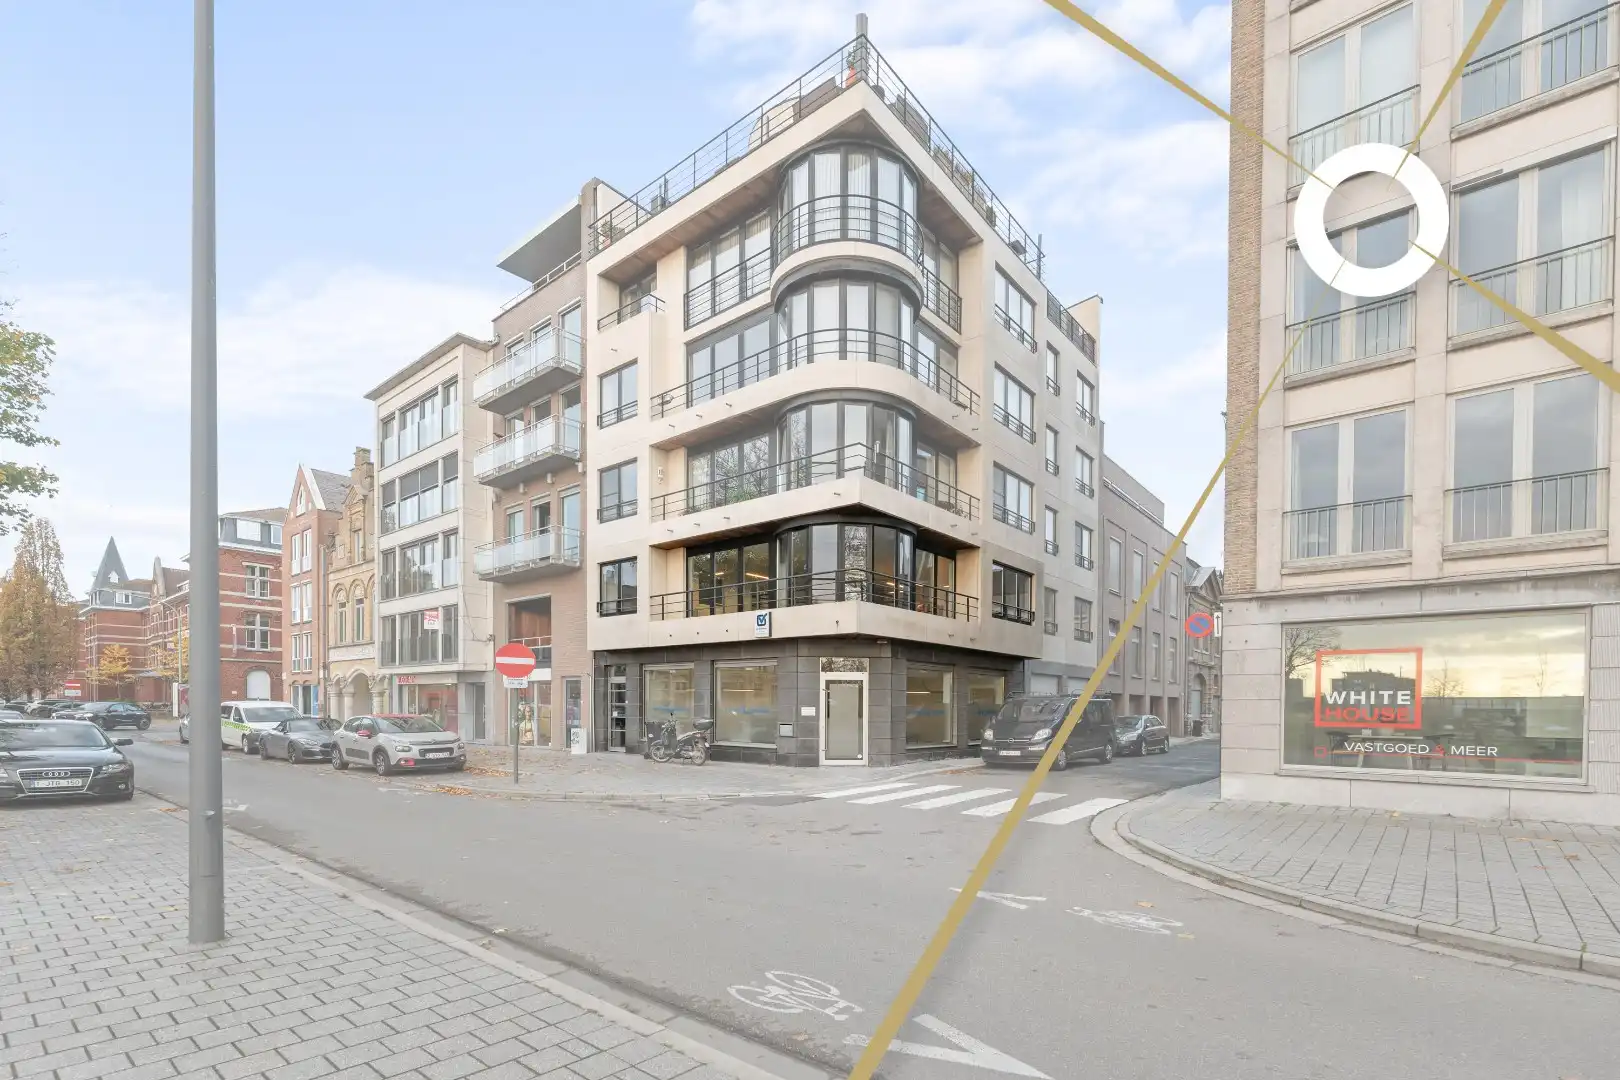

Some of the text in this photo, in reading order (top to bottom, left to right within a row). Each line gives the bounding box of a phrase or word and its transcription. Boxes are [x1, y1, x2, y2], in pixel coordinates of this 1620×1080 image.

[1325, 690, 1411, 705] WHITE
[1325, 707, 1410, 721] HOUSE
[1344, 741, 1429, 754] VASTGOED
[1451, 745, 1498, 757] MEER
